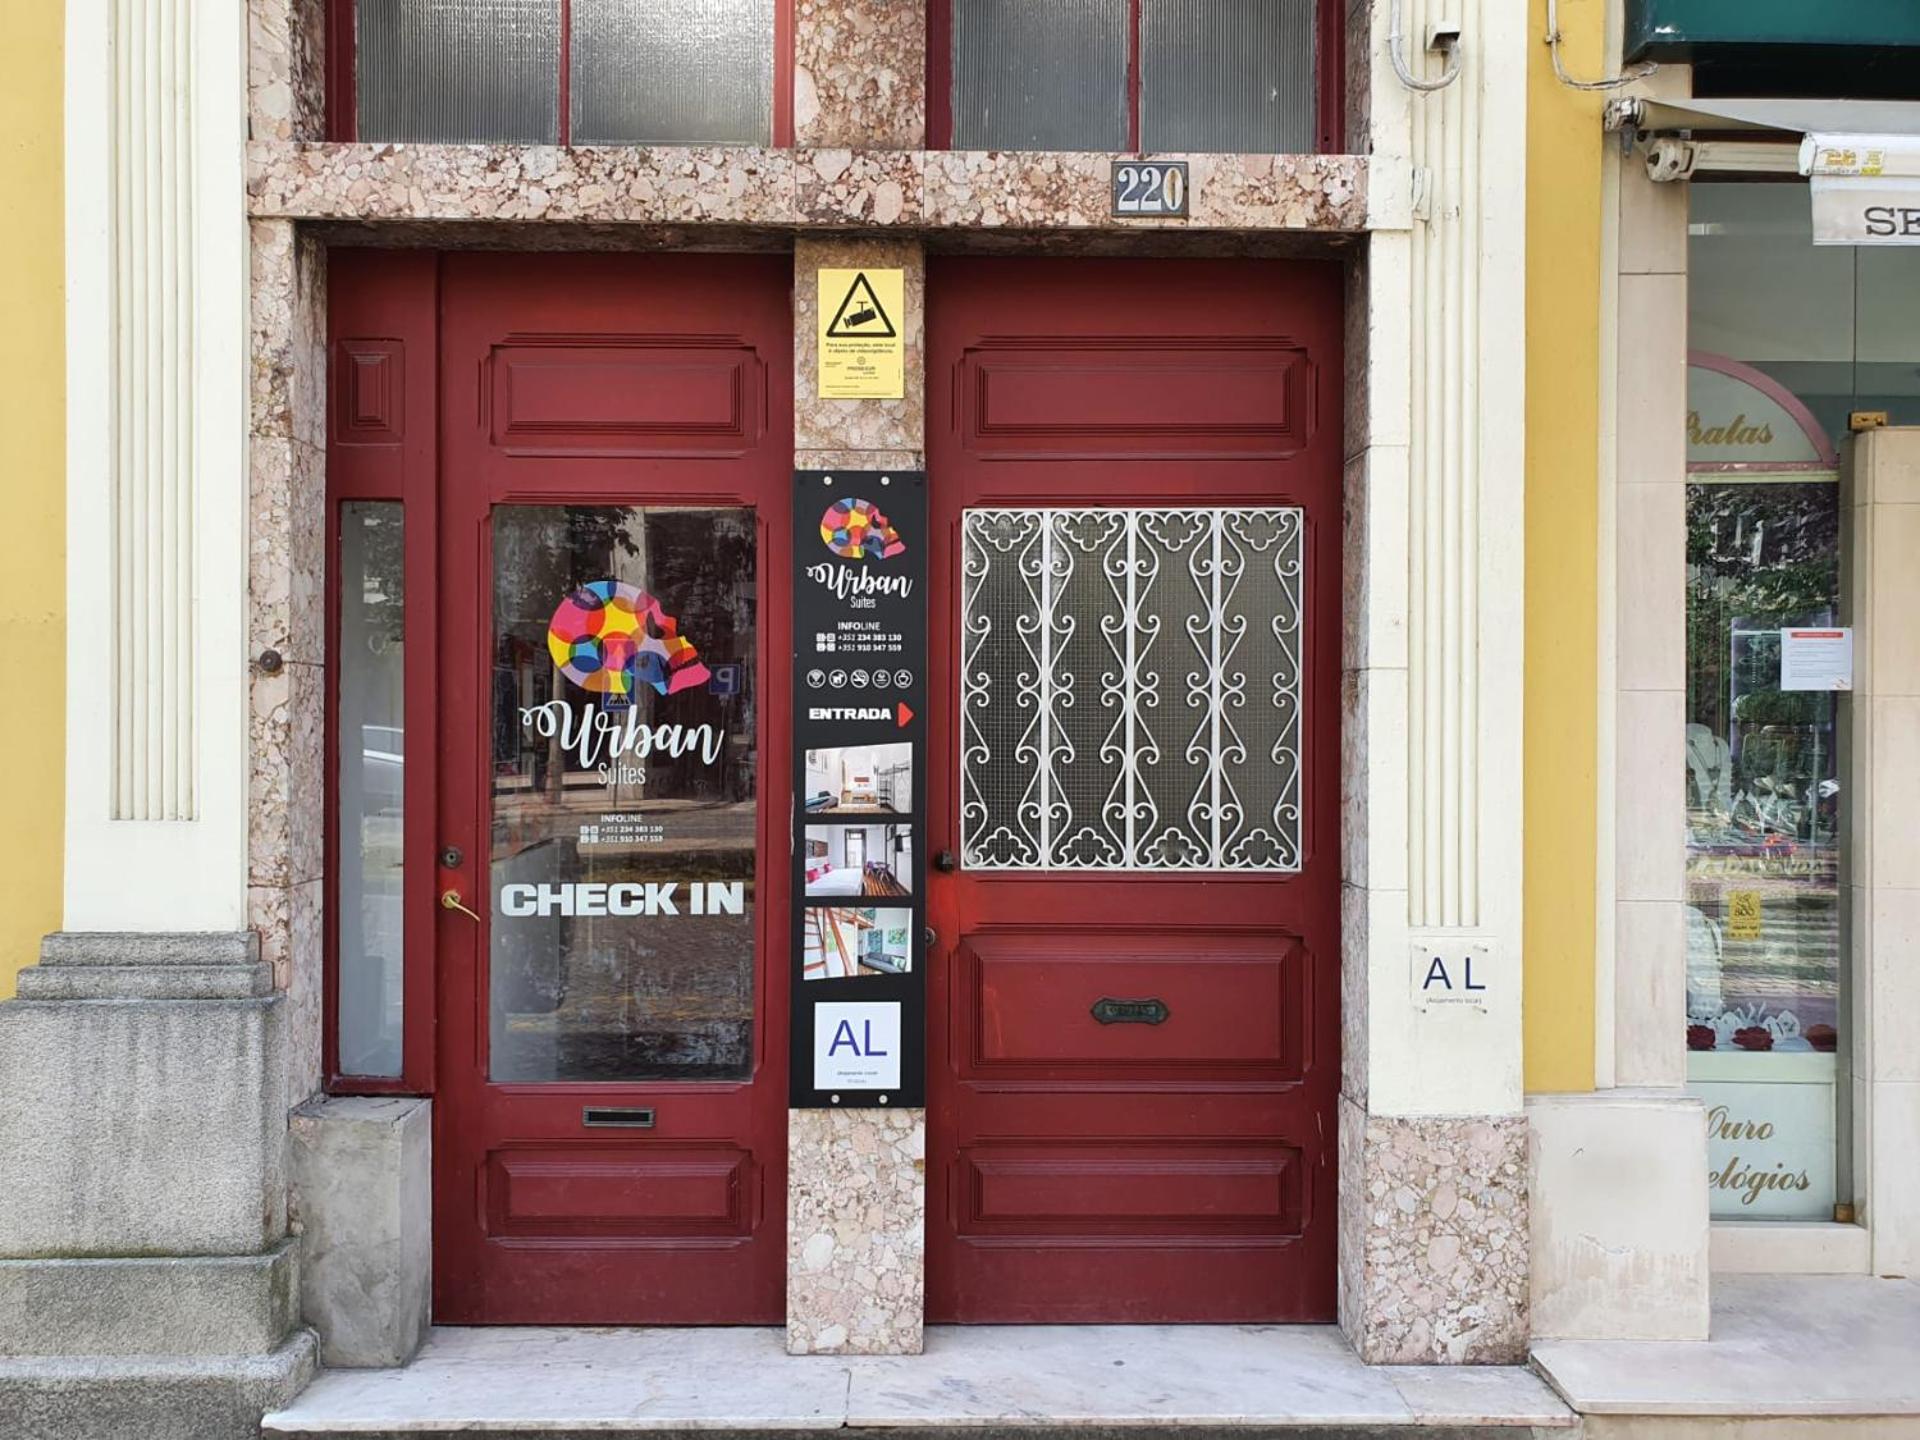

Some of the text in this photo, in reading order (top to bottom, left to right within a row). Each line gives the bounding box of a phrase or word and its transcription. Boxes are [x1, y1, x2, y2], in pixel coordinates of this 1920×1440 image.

[1118, 167, 1184, 211] 220
[806, 563, 912, 600] Urban
[850, 596, 876, 609] Suites
[838, 621, 881, 631] INFOLINE
[809, 708, 892, 720] ENTRADA
[519, 700, 724, 768] Urban
[597, 762, 646, 785] Suites
[601, 814, 643, 823] INFOLINE
[500, 882, 745, 917] CHECK IN
[828, 1020, 888, 1056] AL
[1708, 1105, 1775, 1140] Ouro
[1709, 1156, 1811, 1205] elógios
